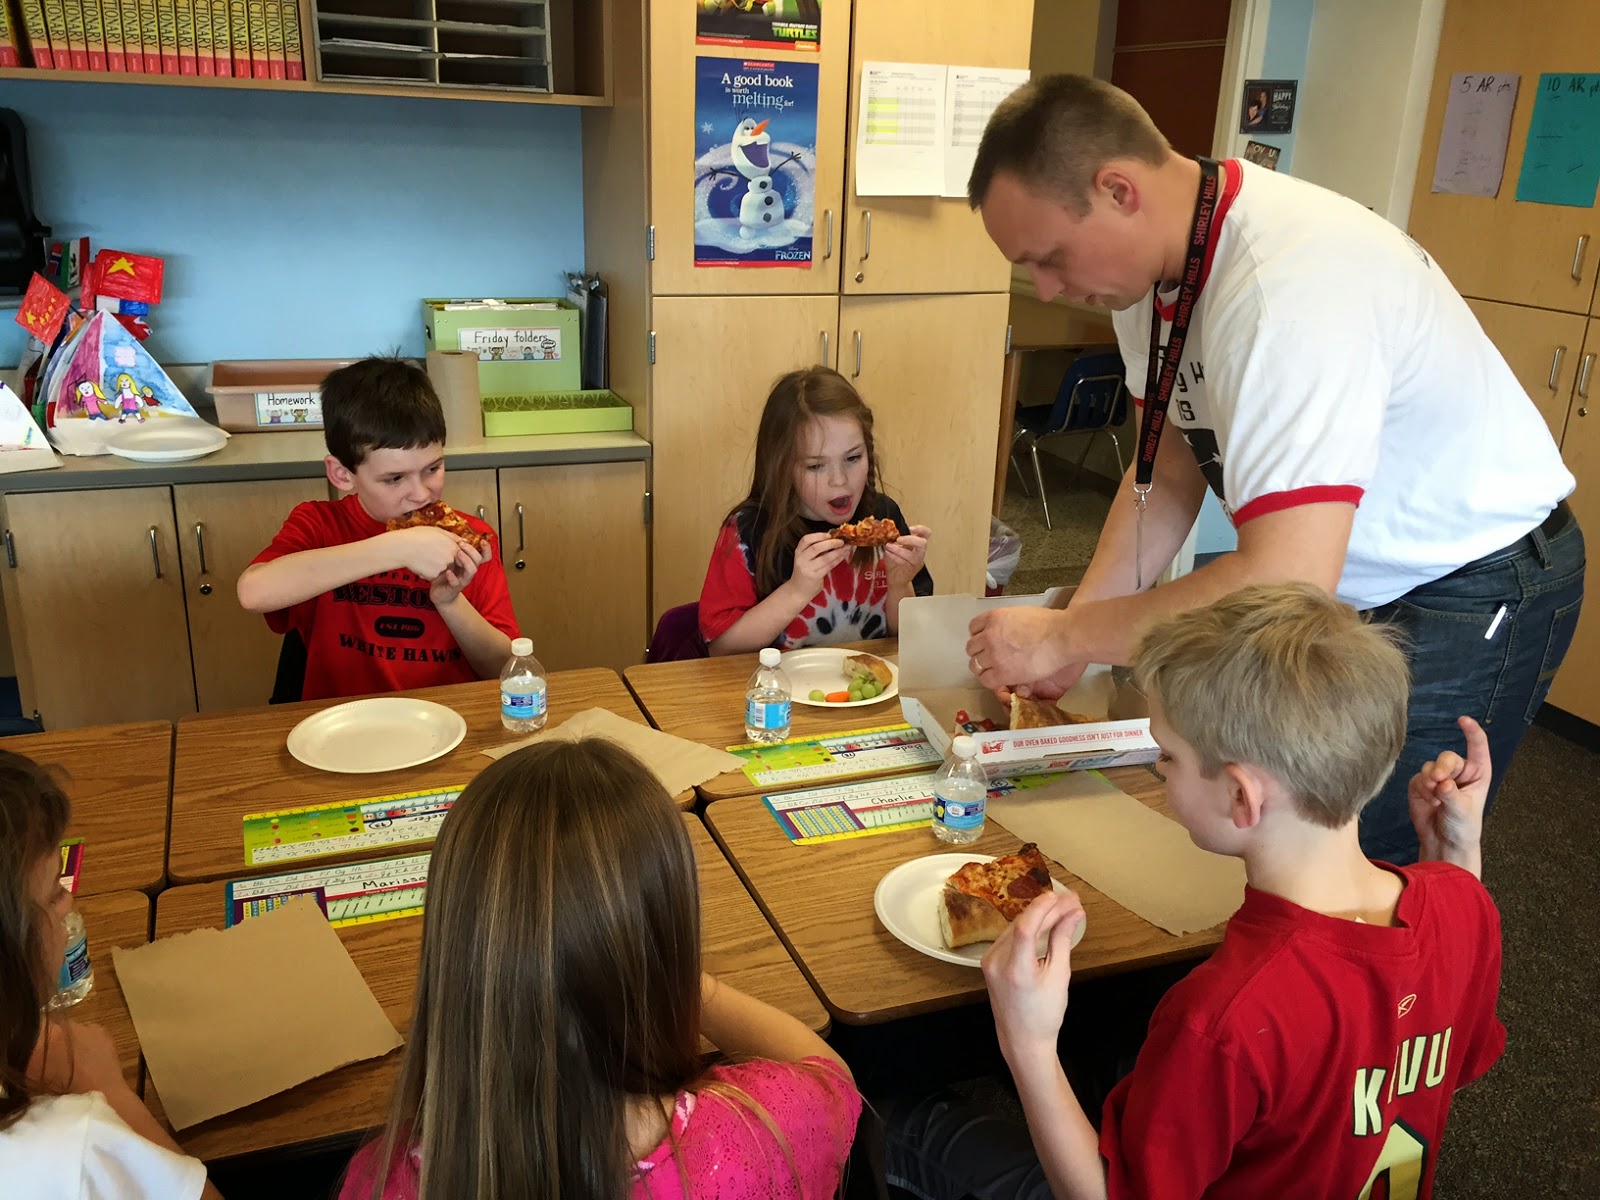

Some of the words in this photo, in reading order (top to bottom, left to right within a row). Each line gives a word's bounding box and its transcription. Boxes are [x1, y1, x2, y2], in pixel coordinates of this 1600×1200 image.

[231, 0, 248, 53] CTIONARY
[282, 0, 300, 56] ICTIONARY
[772, 27, 818, 39] TURTLES
[721, 72, 731, 84] A
[733, 74, 762, 88] good
[765, 74, 794, 88] book
[1461, 76, 1474, 93] 5
[1476, 76, 1496, 93] AR
[1547, 77, 1561, 92] 10
[1567, 76, 1586, 93] AR
[732, 92, 784, 112] melting
[1273, 92, 1292, 102] HAPPY
[1203, 175, 1217, 200] HILLS
[1194, 202, 1213, 246] SHIRLEY
[775, 250, 811, 261] FROZEN
[1176, 285, 1194, 329] SHIRLEY
[1186, 257, 1200, 285] HILLS
[474, 331, 509, 348] Friday
[513, 330, 548, 343] folders
[1158, 363, 1176, 403] SHIRLEY
[1168, 337, 1183, 363] HILLS
[267, 391, 316, 406] Homework
[1143, 430, 1158, 463] SHIRLEY
[1151, 409, 1164, 430] HILLS
[339, 633, 396, 661] WHITE
[1013, 740, 1024, 748] OUR
[1025, 739, 1040, 747] OVEN
[1040, 738, 1058, 746] BAKED
[1058, 735, 1086, 744] GOODNESS
[1113, 731, 1124, 739] FOR
[1124, 729, 1144, 738] DINNER
[871, 794, 915, 805] Charlie
[408, 813, 447, 823] aefer
[363, 876, 427, 889] Marissa
